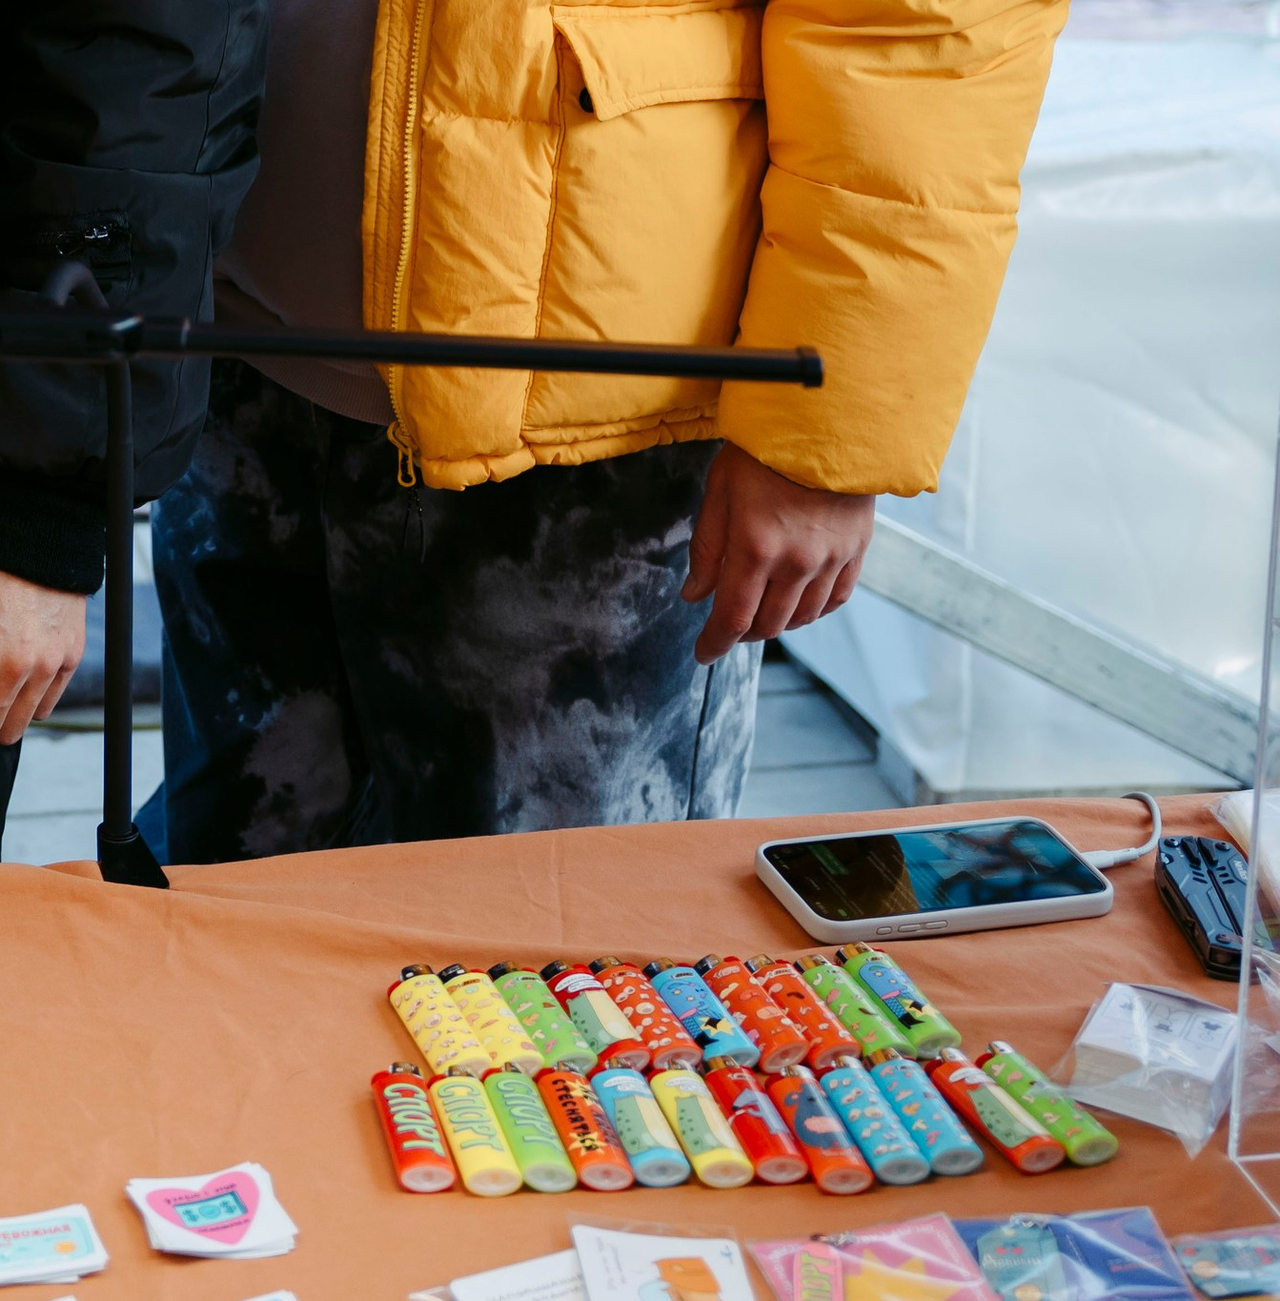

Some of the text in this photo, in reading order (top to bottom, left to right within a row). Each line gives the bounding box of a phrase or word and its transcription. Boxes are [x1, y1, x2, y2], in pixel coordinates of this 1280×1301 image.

[383, 1082, 446, 1157] СПОРТ
[437, 1081, 504, 1152] СПОРТ
[497, 1079, 565, 1157] СПОРТ
